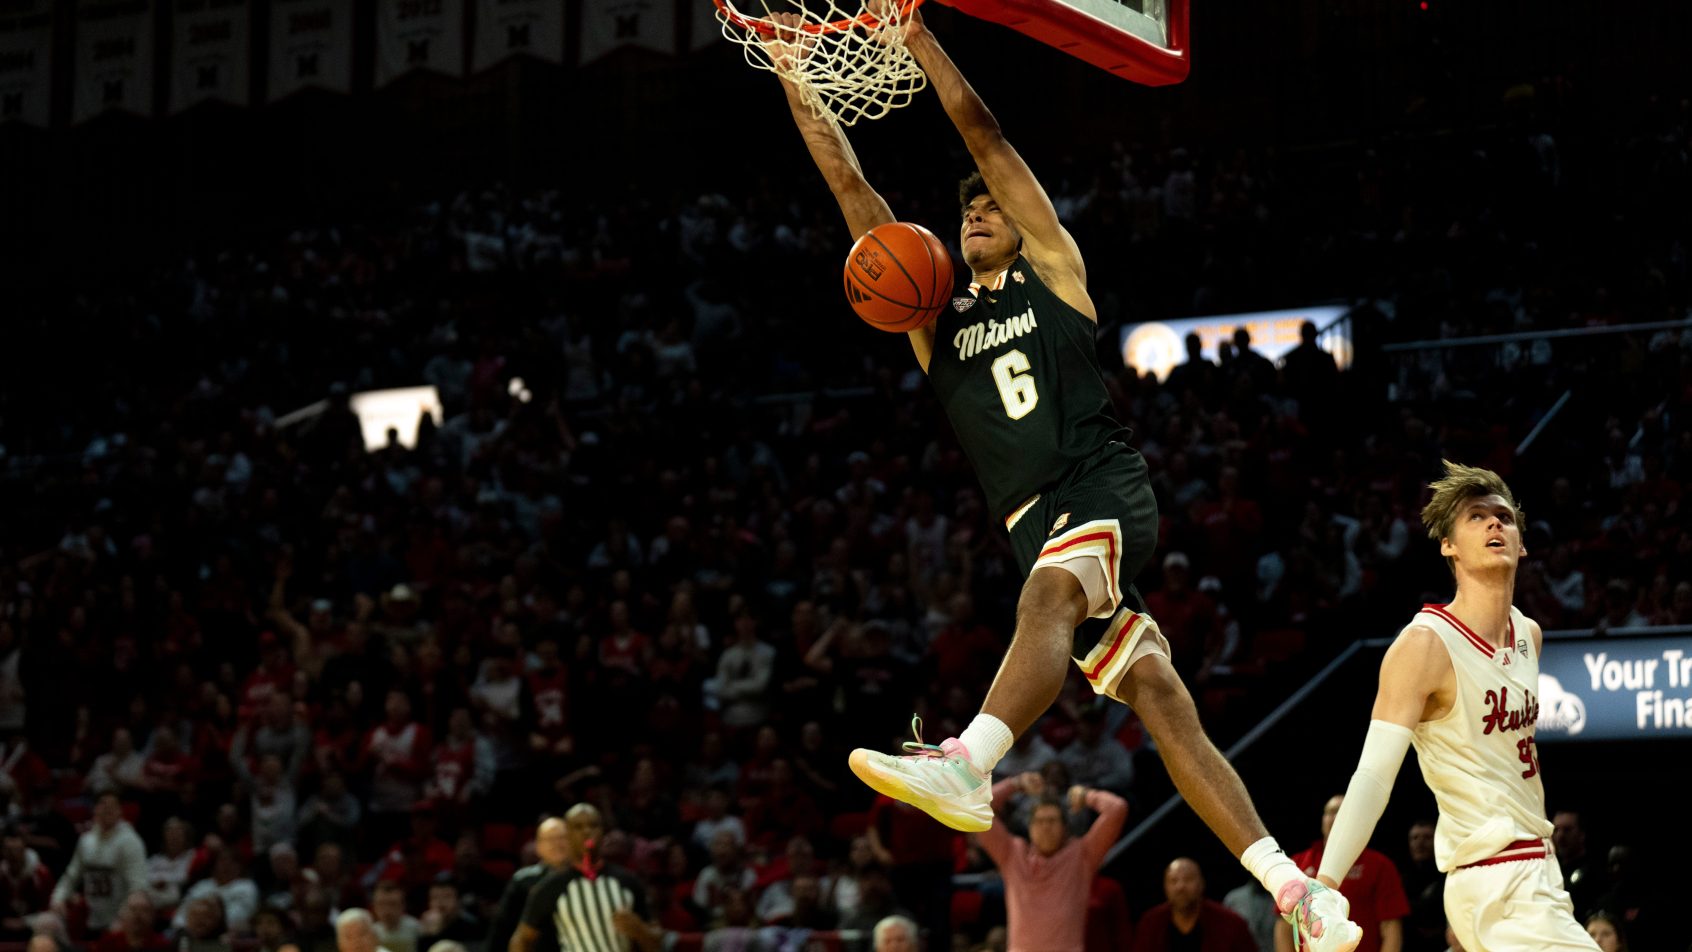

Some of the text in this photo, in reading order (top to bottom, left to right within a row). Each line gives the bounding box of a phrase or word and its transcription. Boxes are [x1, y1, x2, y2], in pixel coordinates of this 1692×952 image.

[953, 302, 1038, 361] Miami
[991, 348, 1039, 420] 6
[1584, 650, 1692, 690] Your Tr
